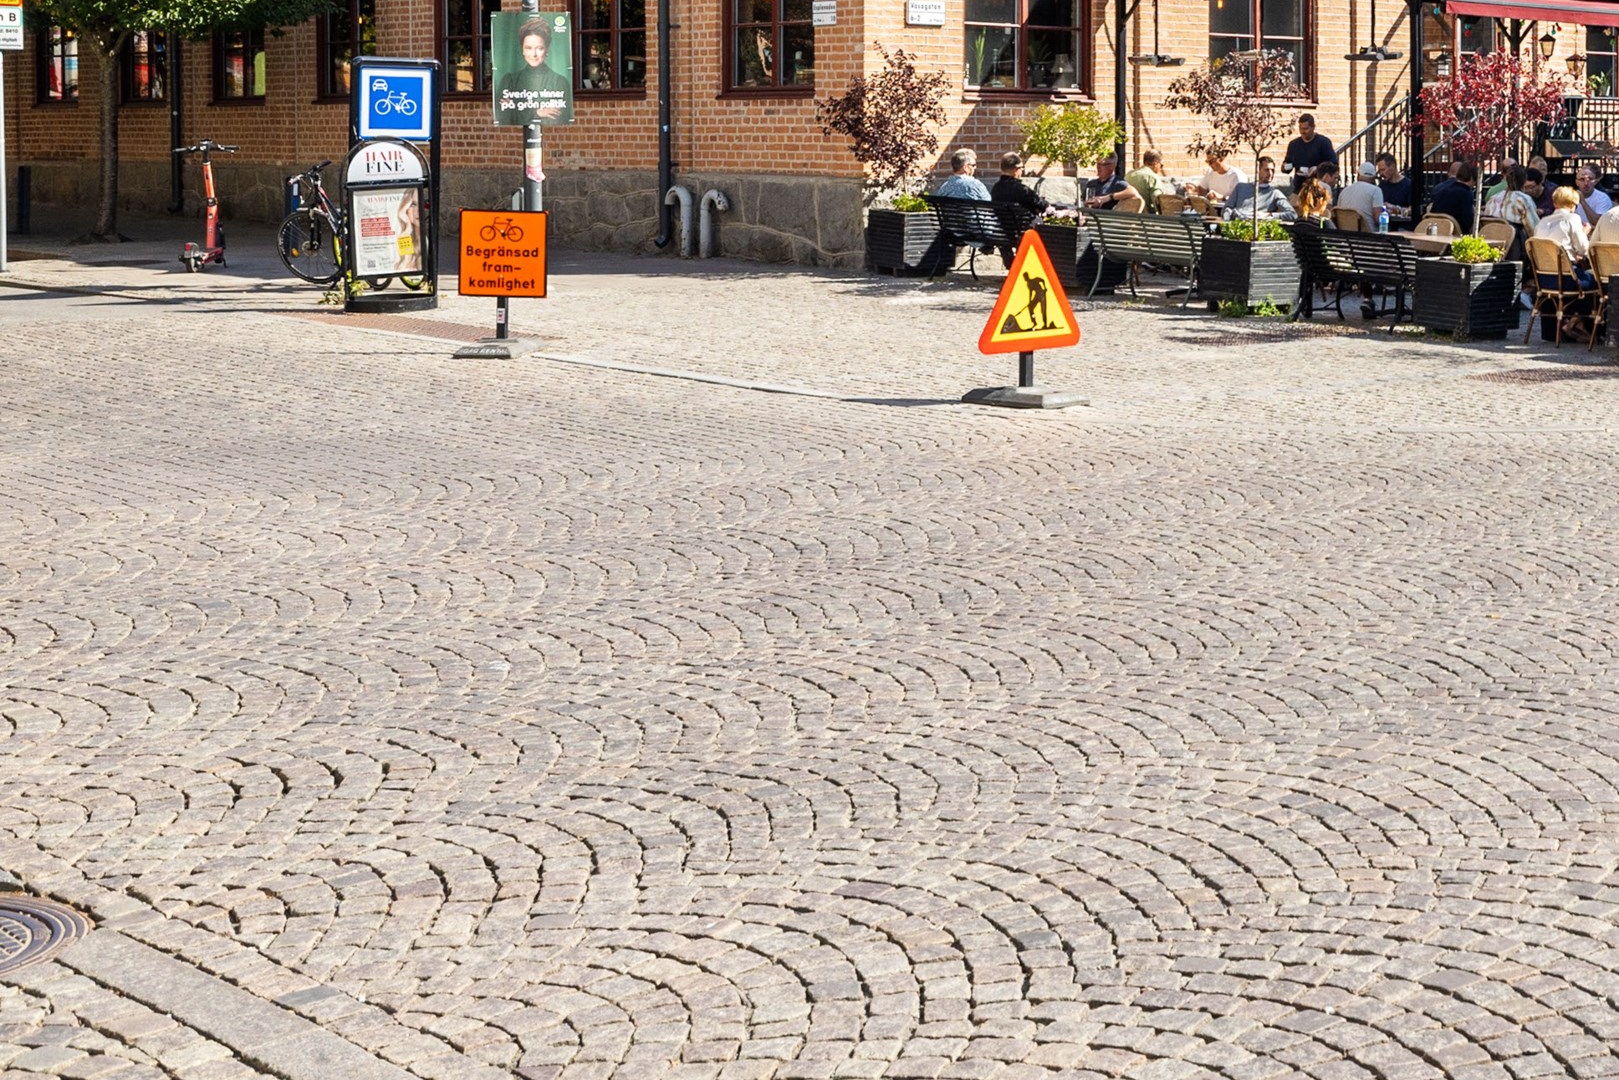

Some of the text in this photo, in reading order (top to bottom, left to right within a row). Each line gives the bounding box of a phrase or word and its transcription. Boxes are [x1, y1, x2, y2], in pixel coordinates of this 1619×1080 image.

[910, 2, 942, 11] Vasagatan
[9, 12, 17, 22] B
[502, 89, 565, 100] Sverige vinner
[501, 99, 567, 111] på grön politik
[365, 150, 404, 161] HAIR
[366, 161, 405, 173] FINE
[466, 245, 539, 259] Begränsad
[482, 261, 522, 273] fram-
[468, 277, 535, 291] komlighet
